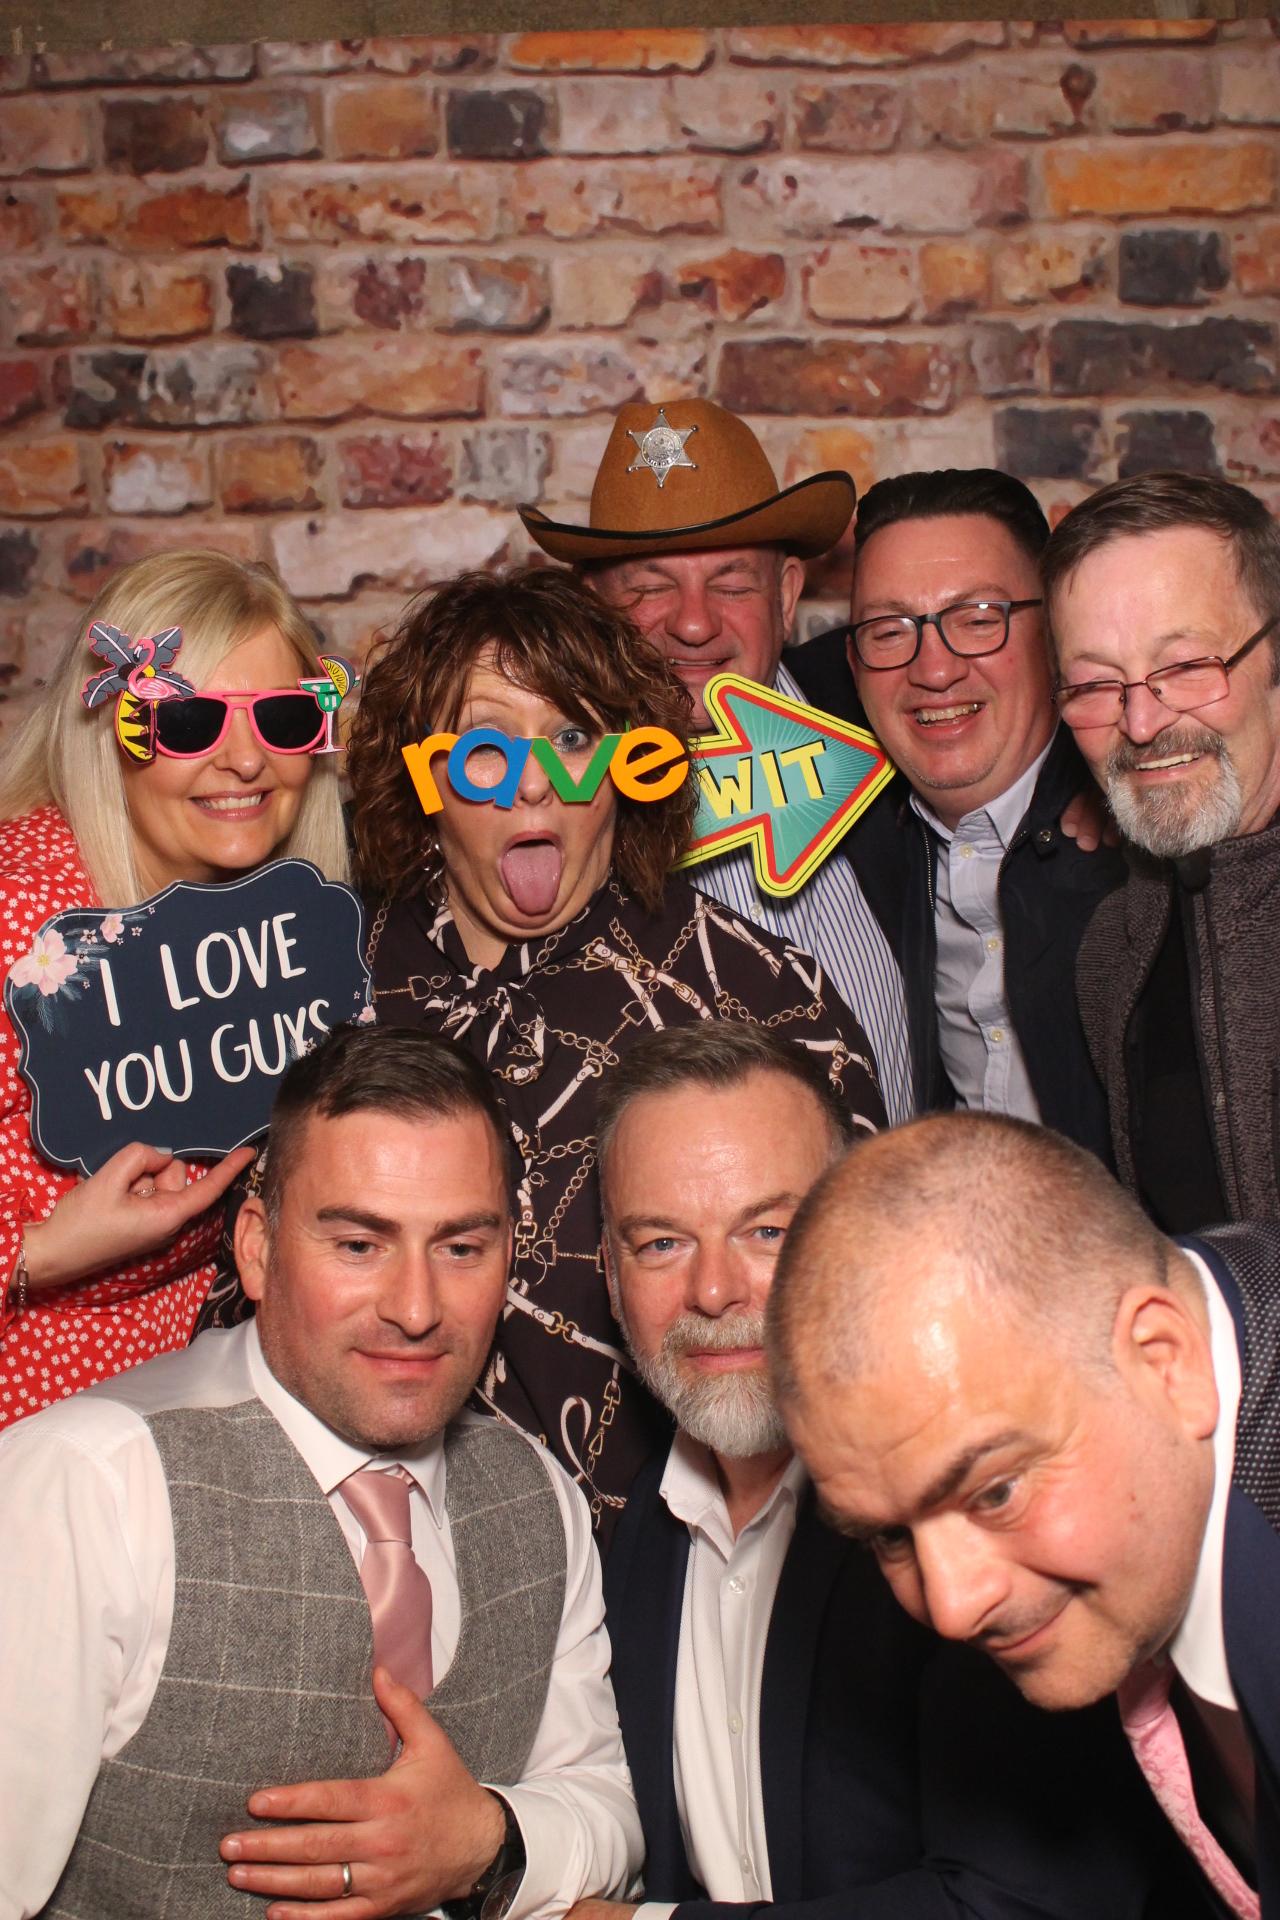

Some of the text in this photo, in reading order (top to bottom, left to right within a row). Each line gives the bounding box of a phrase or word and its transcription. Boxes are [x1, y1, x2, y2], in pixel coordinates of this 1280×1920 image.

[401, 726, 689, 816] rave
[697, 739, 827, 819] WIT
[100, 912, 307, 1027] I LOVE
[84, 1038, 193, 1121] YOU
